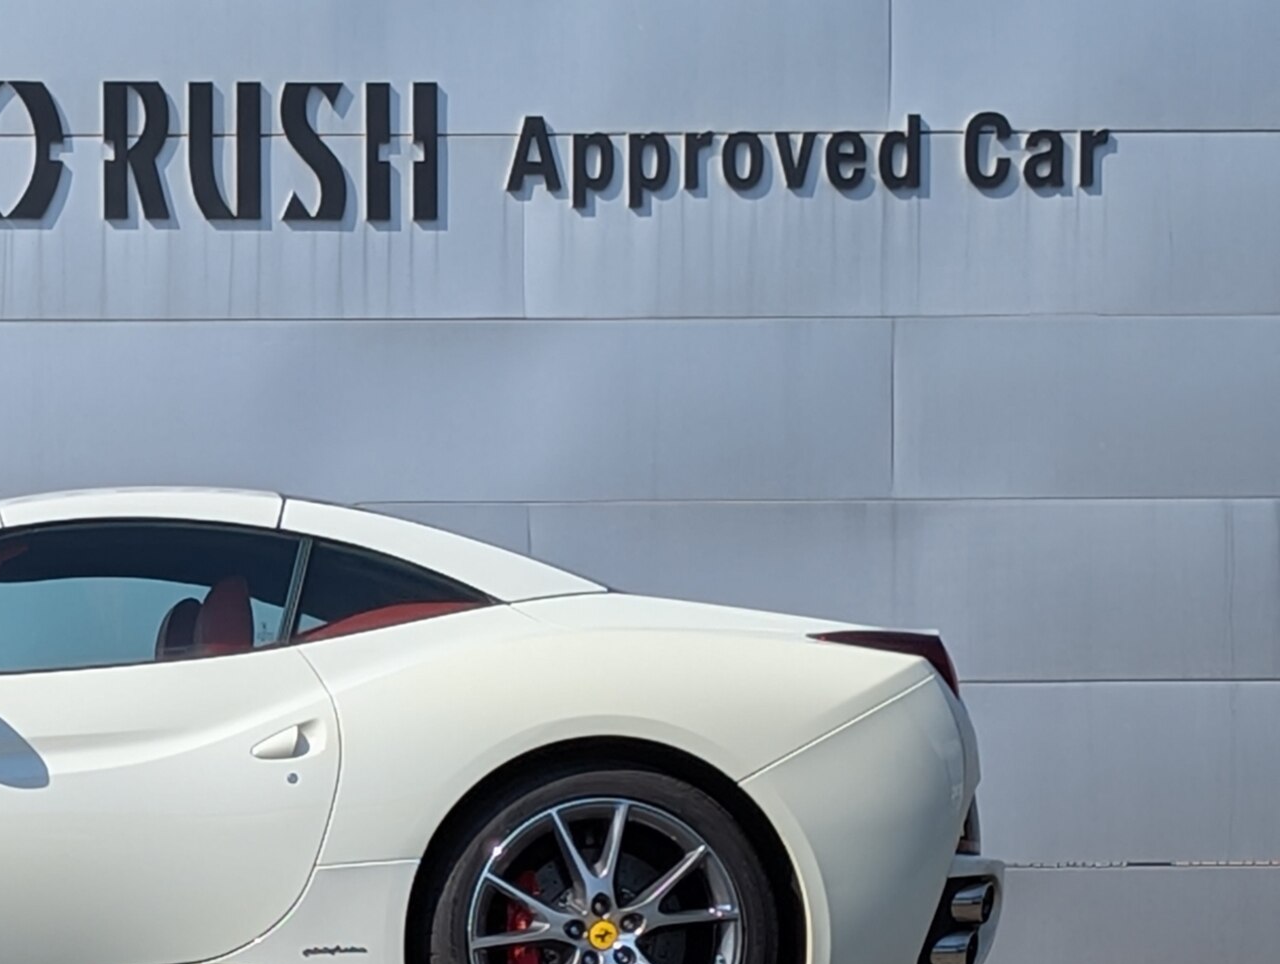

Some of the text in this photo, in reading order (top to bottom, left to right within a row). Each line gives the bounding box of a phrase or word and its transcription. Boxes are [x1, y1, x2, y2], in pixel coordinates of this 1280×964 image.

[103, 81, 438, 220] RUSH
[506, 111, 1110, 208] Approved Car
